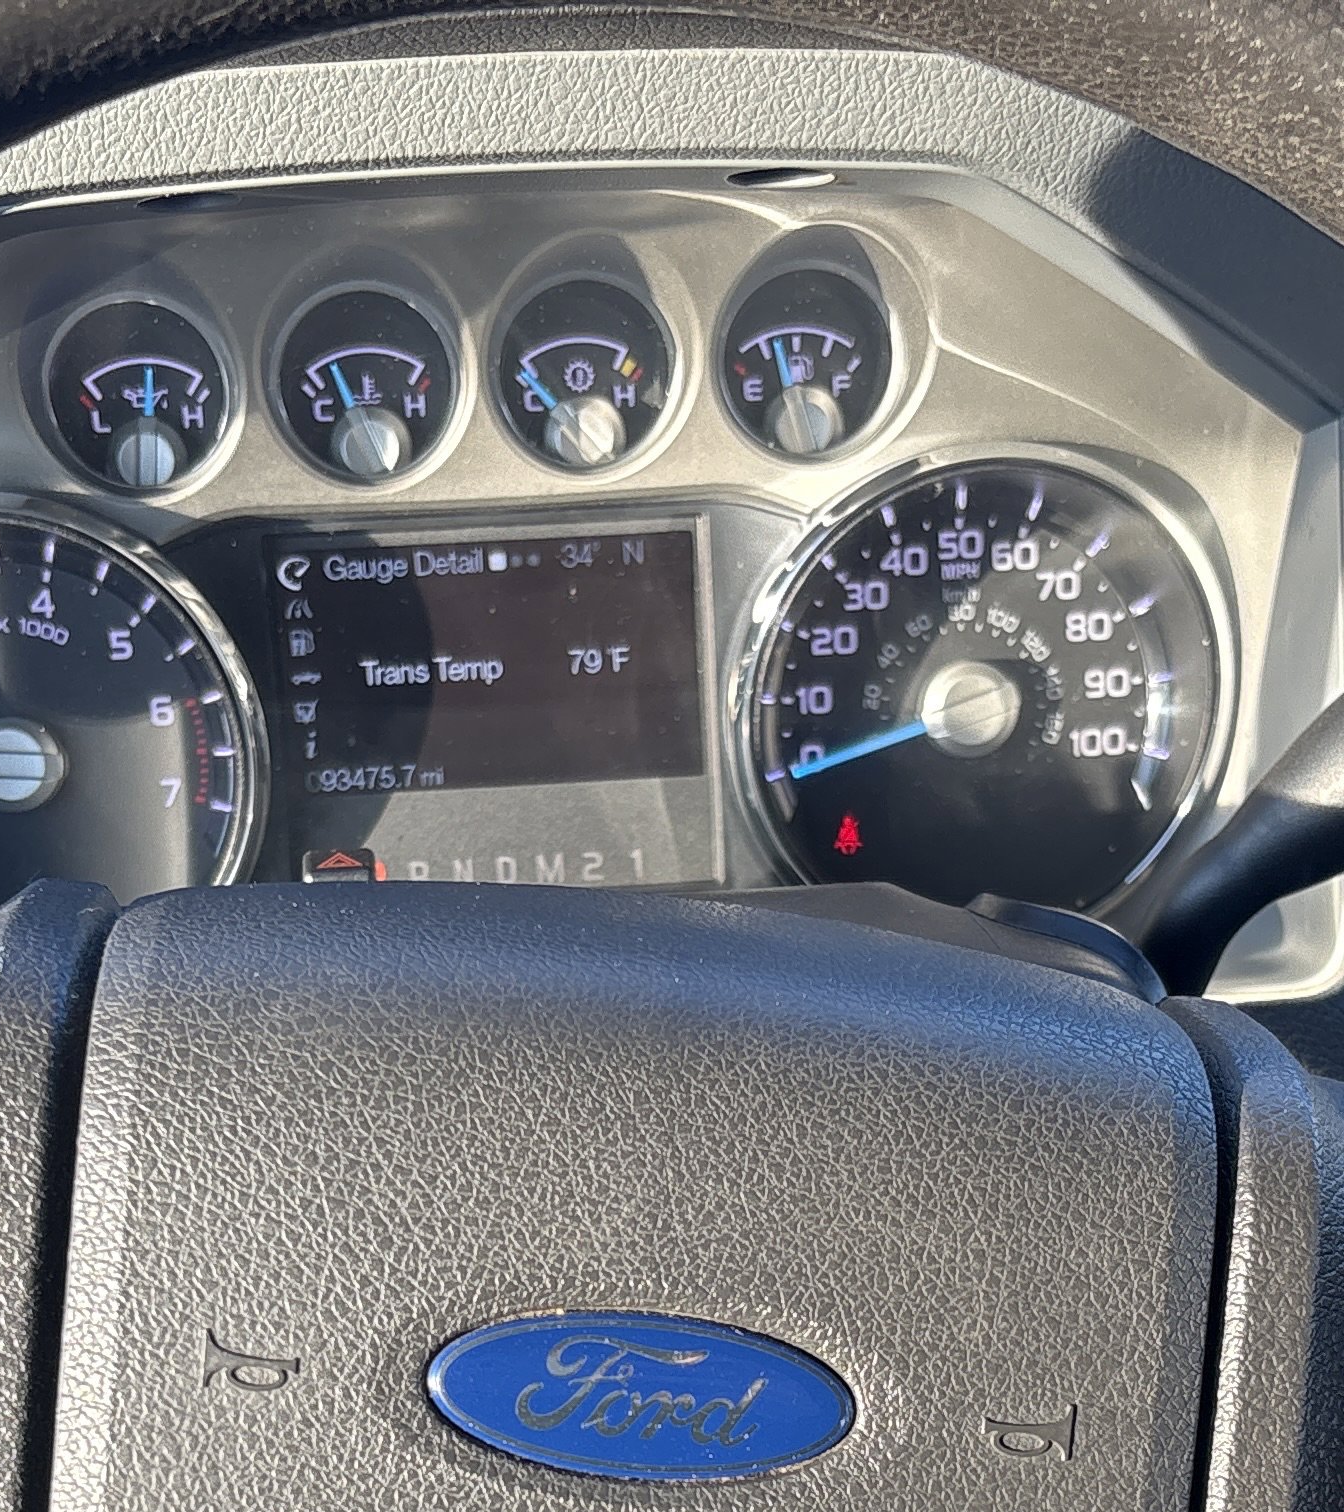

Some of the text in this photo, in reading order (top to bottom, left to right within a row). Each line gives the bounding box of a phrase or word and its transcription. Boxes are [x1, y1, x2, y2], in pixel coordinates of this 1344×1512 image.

[613, 384, 637, 408] H
[743, 375, 764, 402] E
[832, 373, 852, 399] F
[91, 409, 112, 433] L
[181, 404, 204, 429] H
[312, 398, 336, 422] C
[404, 393, 427, 418] H
[621, 539, 645, 566] N
[937, 529, 985, 561] 50
[991, 542, 1040, 573] 60
[323, 547, 484, 584] Gauge Detail
[880, 546, 929, 577] 40
[941, 561, 982, 581] MPH
[844, 580, 890, 612] 30
[1035, 570, 1082, 602] 70
[29, 587, 56, 619] 4
[17, 616, 70, 646] 1000
[810, 625, 858, 656] 20
[1065, 611, 1113, 643] 80
[108, 630, 134, 661] 5
[358, 658, 431, 687] Trans
[432, 655, 504, 686] Temp
[567, 648, 603, 676] 79
[1084, 668, 1132, 699] 90
[149, 696, 176, 728] 6
[797, 685, 834, 715] 10
[1069, 726, 1129, 758] 100
[419, 766, 444, 787] mi
[160, 777, 183, 809] 7
[515, 1331, 769, 1450] Ford
